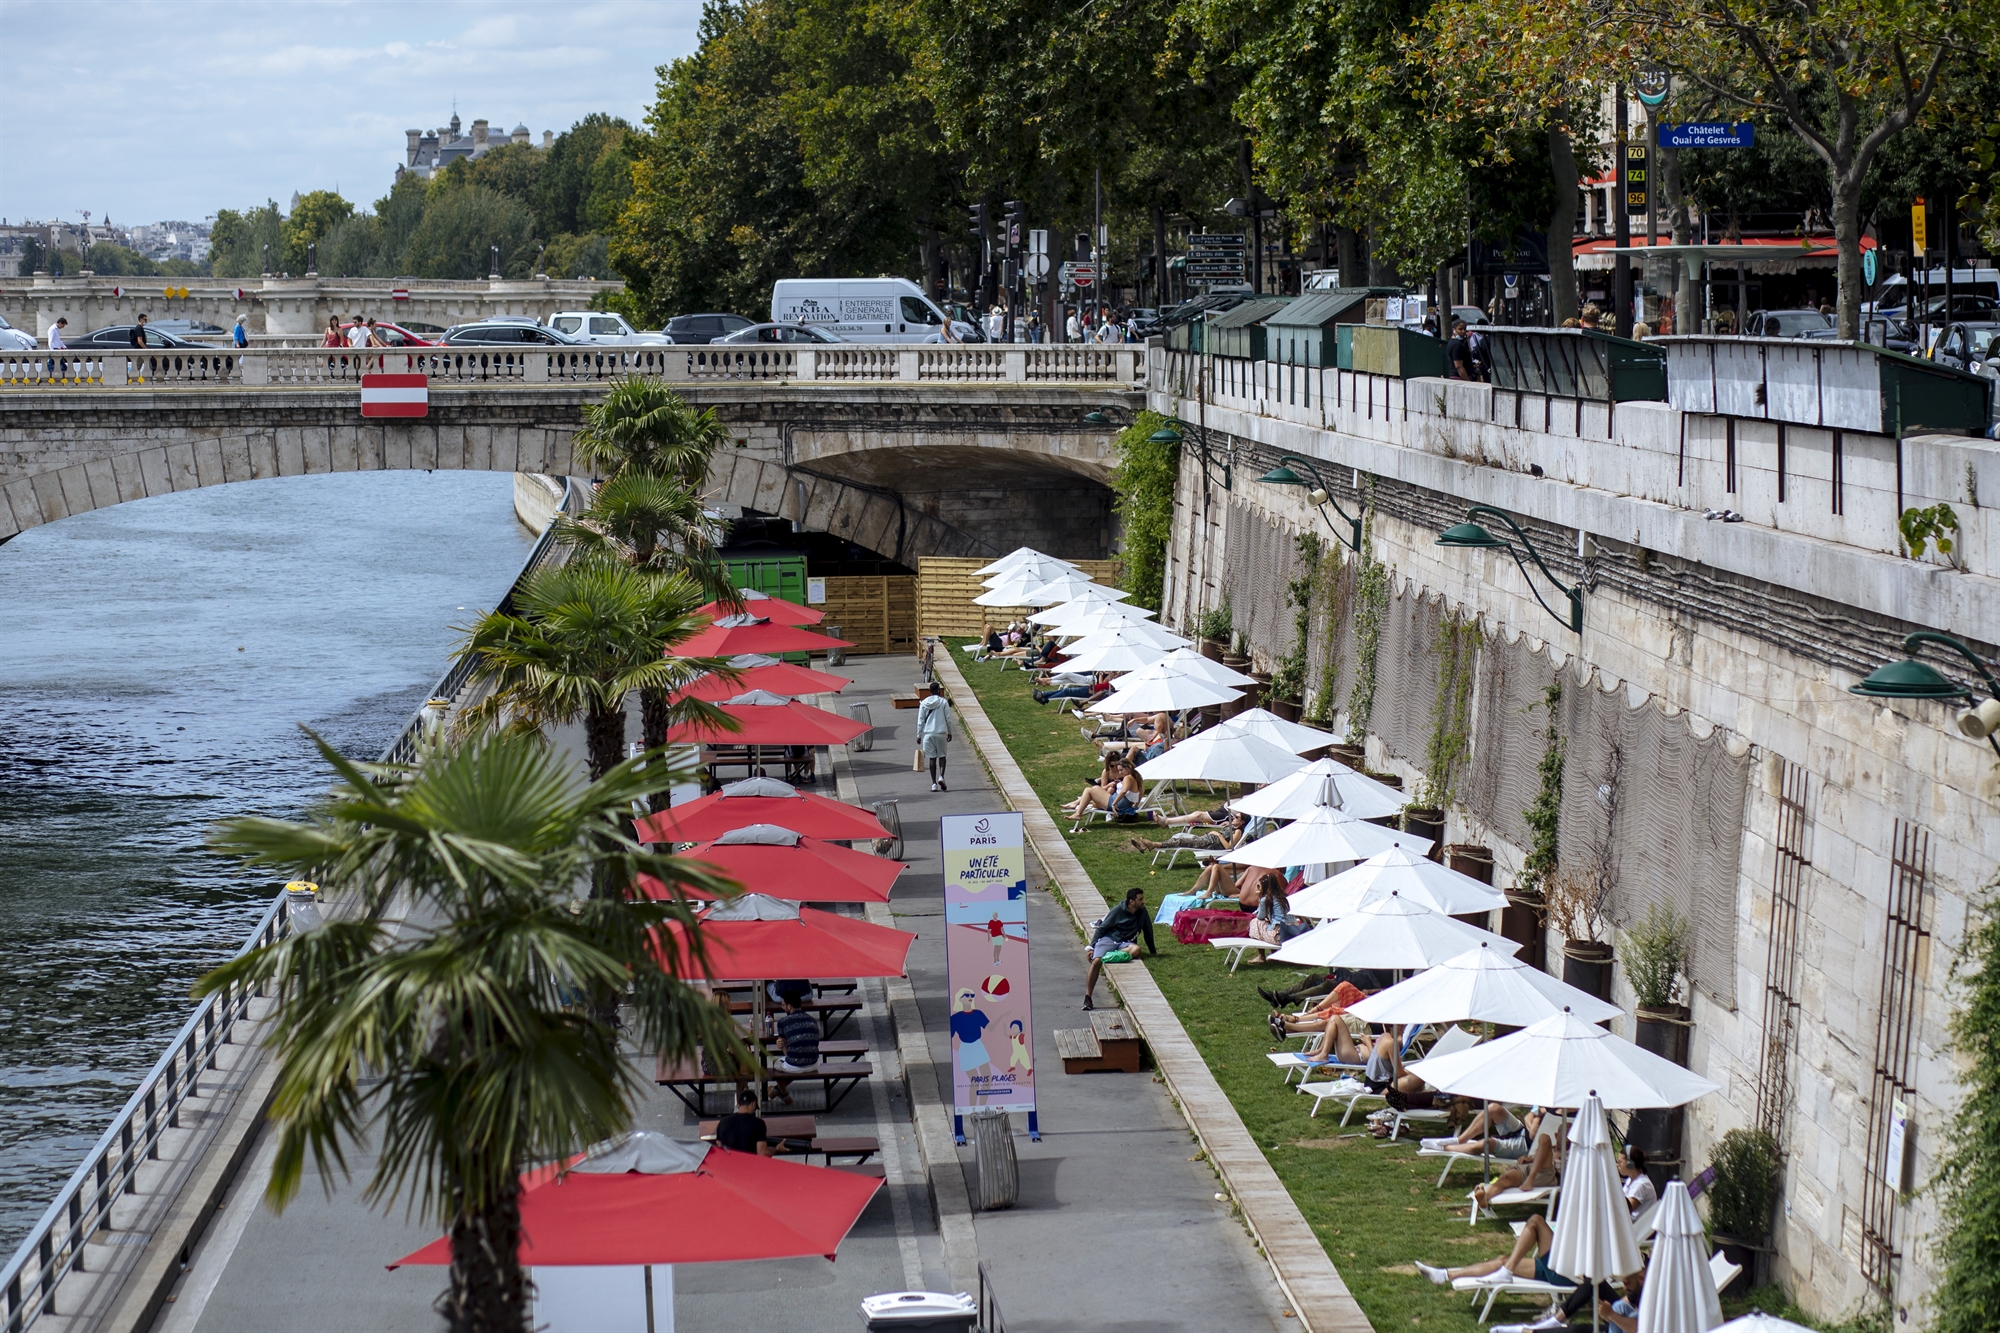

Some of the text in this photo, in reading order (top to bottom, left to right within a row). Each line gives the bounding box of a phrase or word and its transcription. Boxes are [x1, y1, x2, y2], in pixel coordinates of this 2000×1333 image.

[1688, 126, 1724, 134] Châtelet
[1672, 136, 1741, 145] Quai de Gesvres
[1630, 148, 1643, 157] 70
[1630, 171, 1643, 179] 74
[1630, 194, 1643, 203] 96
[970, 836, 997, 845] PARIS
[969, 855, 999, 868] UN ÉTÉ
[960, 868, 1010, 880] PARTICULIER
[971, 1073, 1017, 1083] PARIS PLAGES
